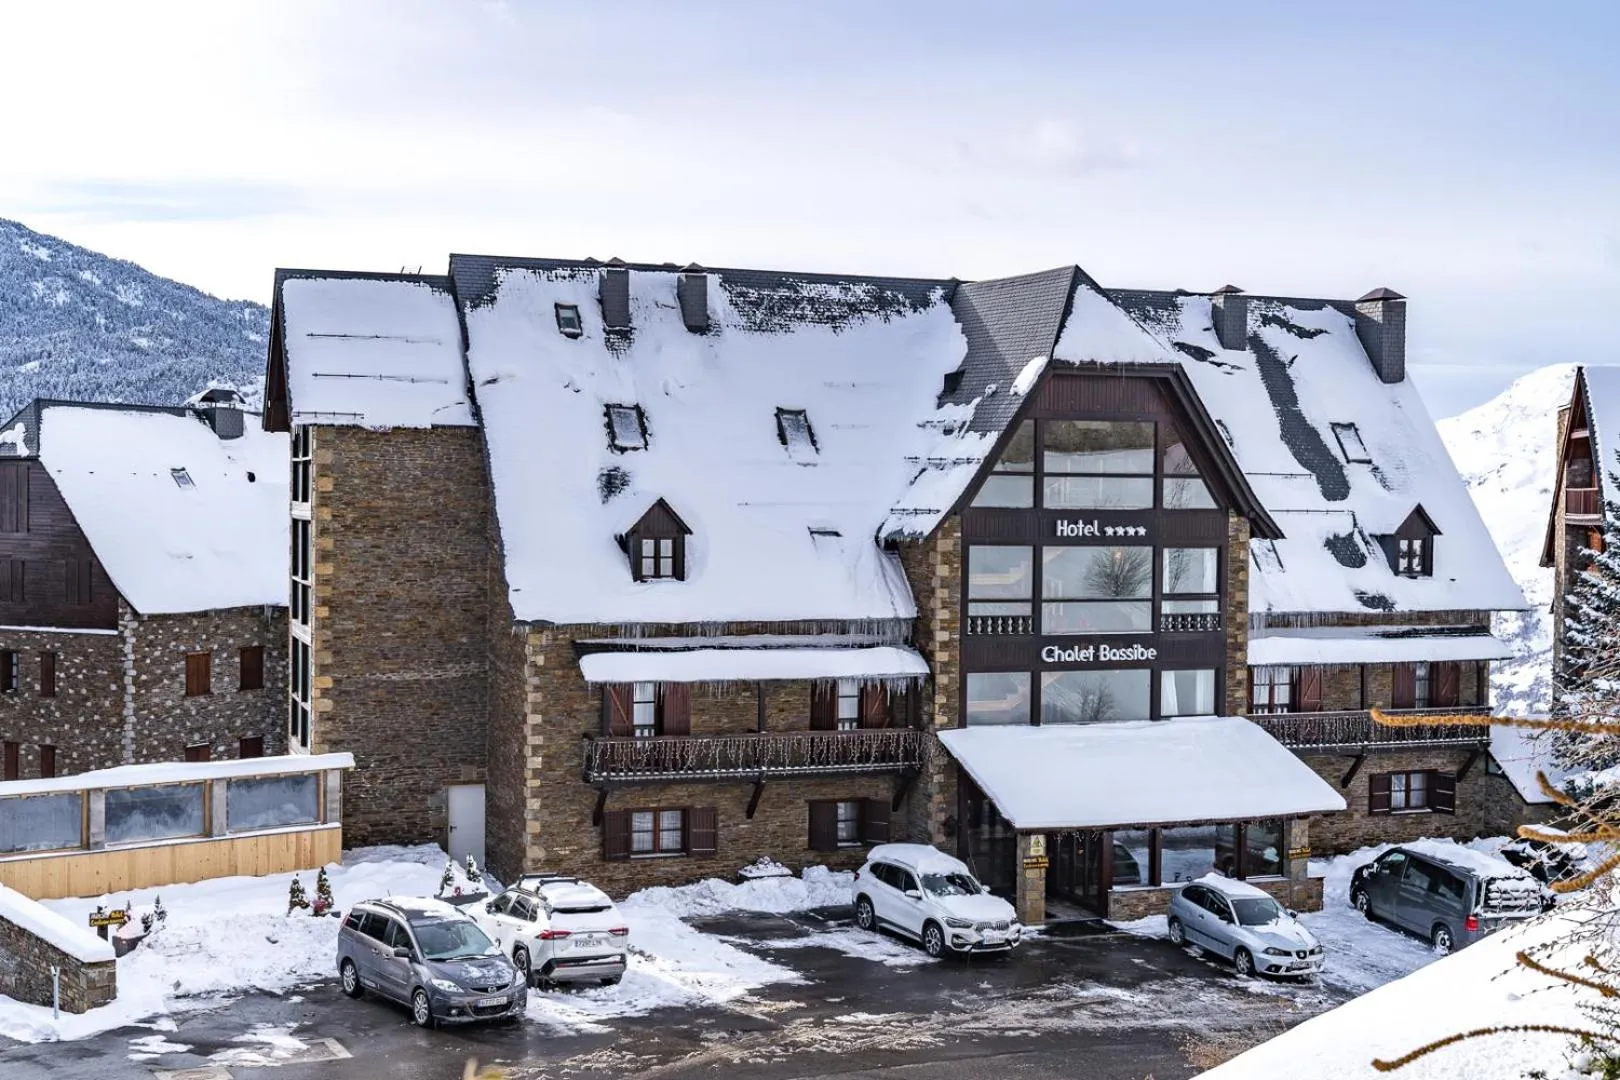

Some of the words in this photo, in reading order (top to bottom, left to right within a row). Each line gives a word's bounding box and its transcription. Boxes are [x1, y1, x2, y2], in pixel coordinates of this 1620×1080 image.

[1056, 519, 1100, 537] Hotel
[1041, 645, 1095, 662] Chalet
[1099, 643, 1157, 661] Bassibe
